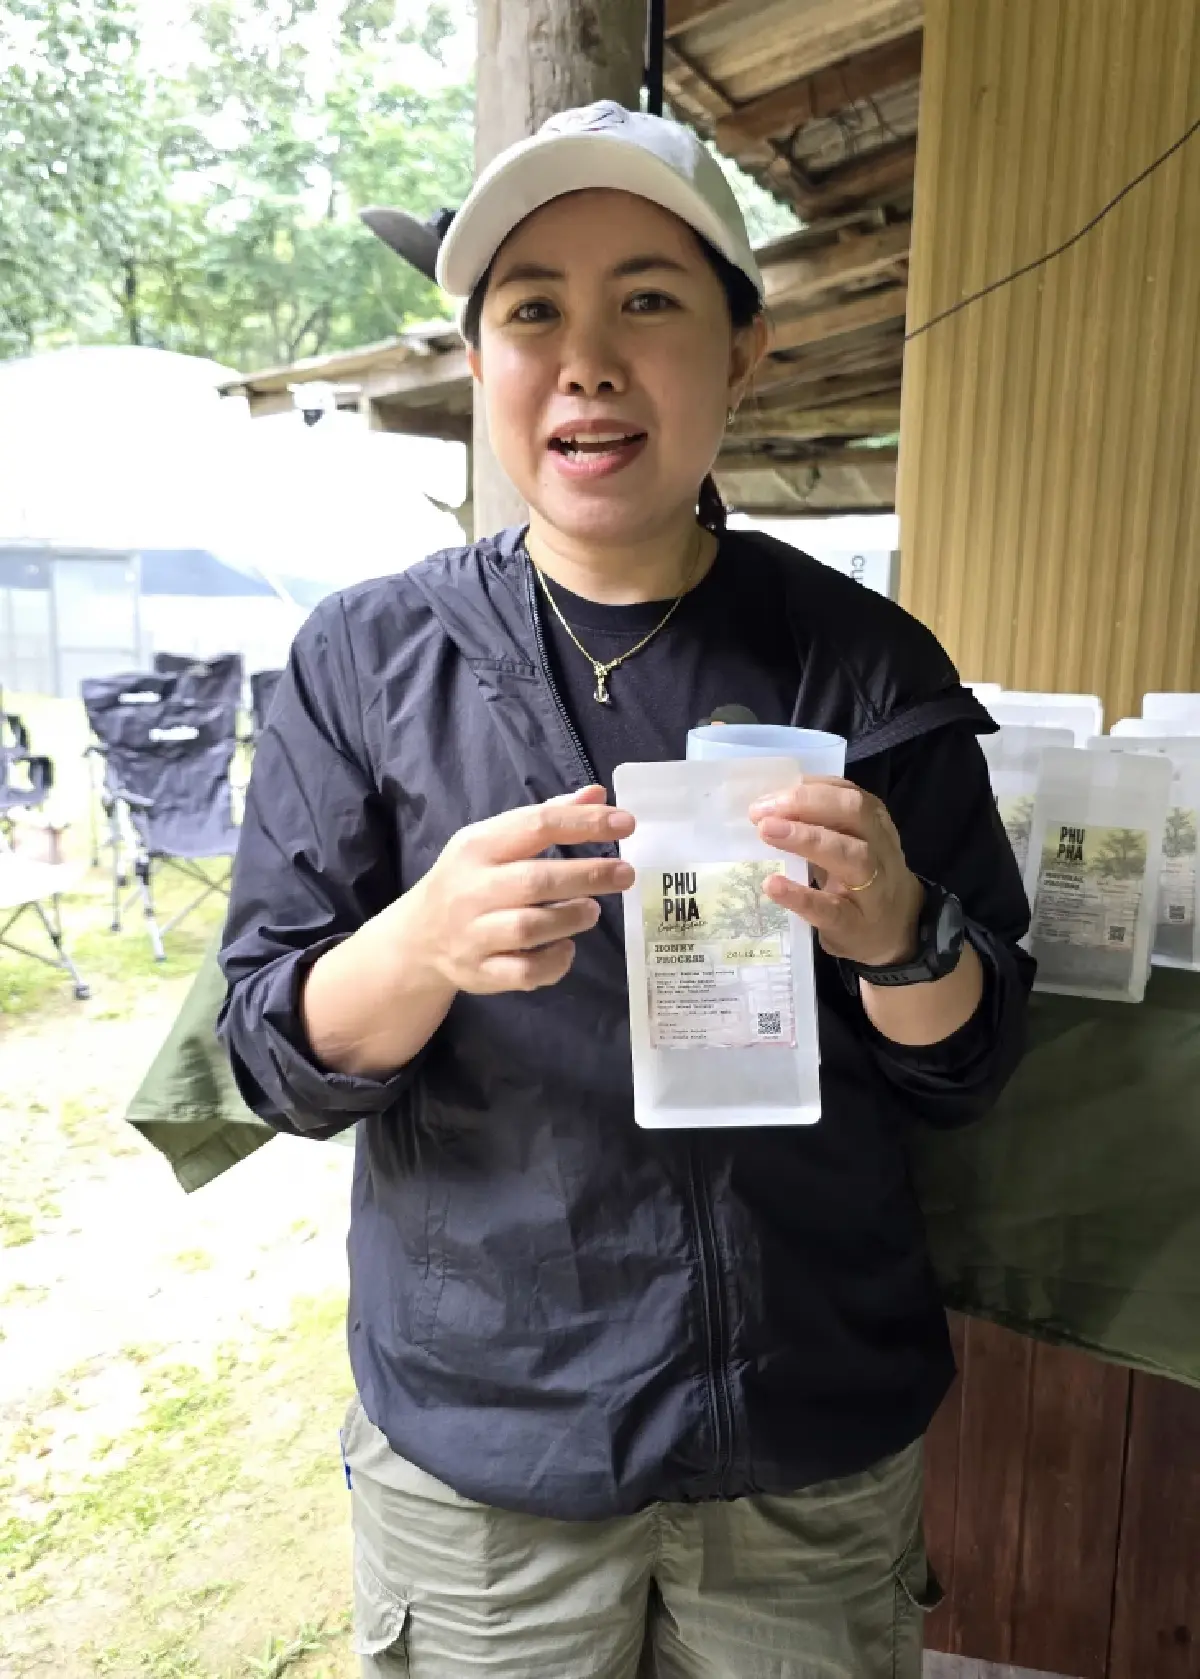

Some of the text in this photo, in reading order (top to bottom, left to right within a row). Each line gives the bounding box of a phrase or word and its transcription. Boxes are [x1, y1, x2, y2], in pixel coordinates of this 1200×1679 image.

[1060, 826, 1085, 844] PHU
[1057, 844, 1082, 860] PHA
[663, 872, 697, 896] PHU
[664, 898, 700, 921] PHA
[654, 943, 695, 953] HONEY
[656, 954, 705, 963] PROCESS
